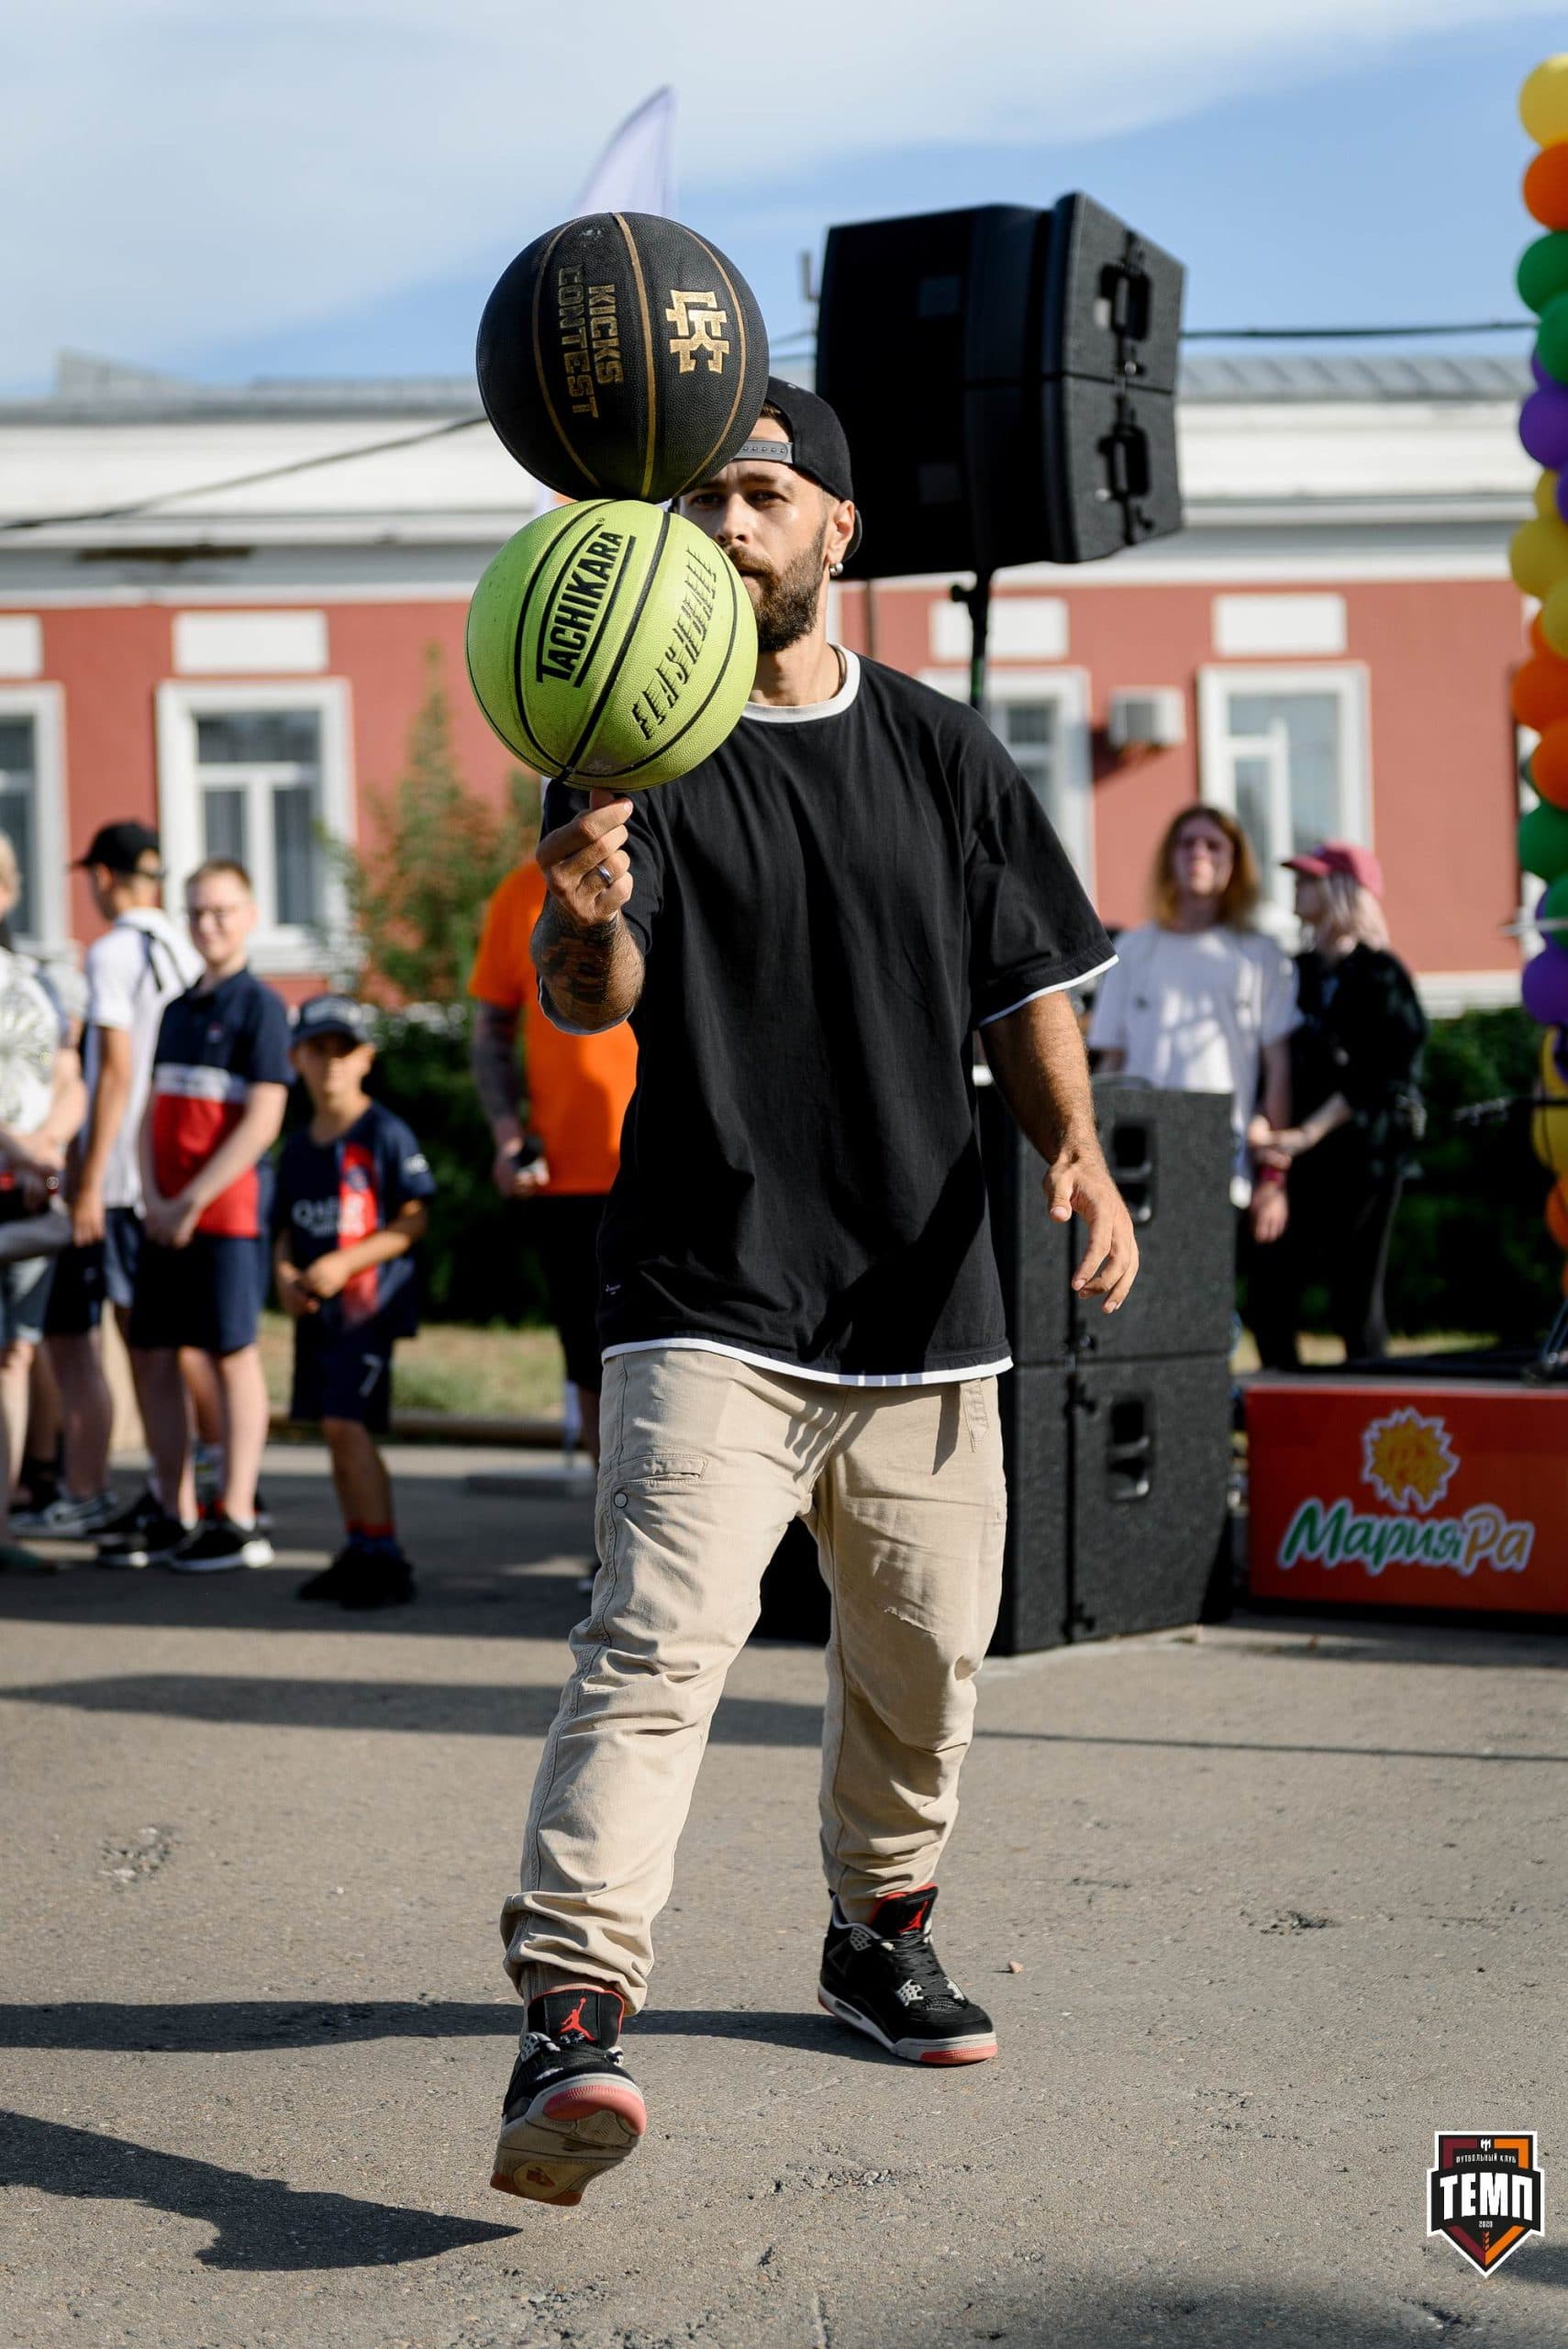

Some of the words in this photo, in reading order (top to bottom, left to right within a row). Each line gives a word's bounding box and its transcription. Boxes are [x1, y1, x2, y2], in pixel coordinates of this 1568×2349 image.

[557, 264, 599, 419] CONTEST
[588, 283, 625, 385] KICKS
[536, 521, 623, 685] TACHIKARA
[358, 1353, 383, 1396] 7
